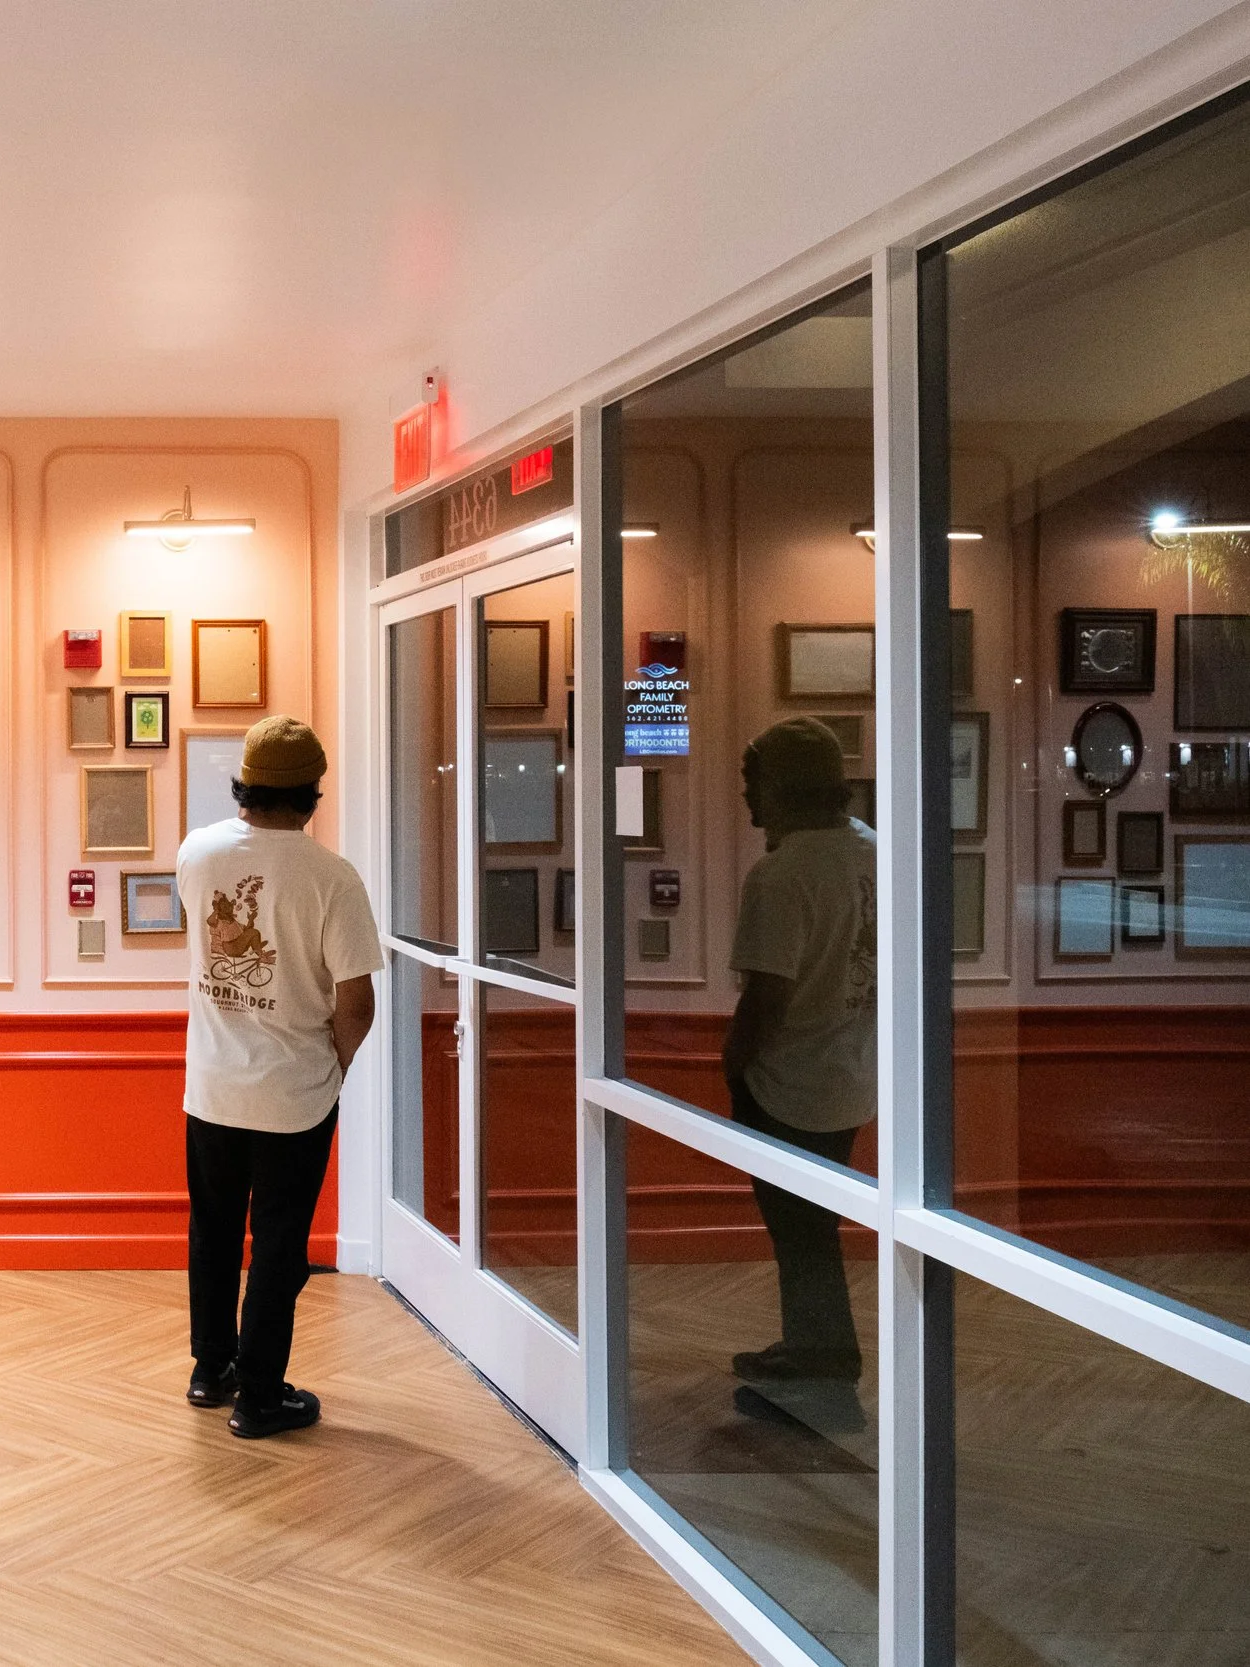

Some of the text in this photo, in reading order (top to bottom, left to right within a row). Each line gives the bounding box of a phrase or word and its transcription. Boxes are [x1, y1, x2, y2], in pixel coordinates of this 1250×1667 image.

[624, 680, 689, 690] LONG BEACH
[640, 693, 674, 702] FAMILY
[627, 704, 687, 714] OPTOMETRY
[198, 981, 276, 1010] MOONBRIDGE
